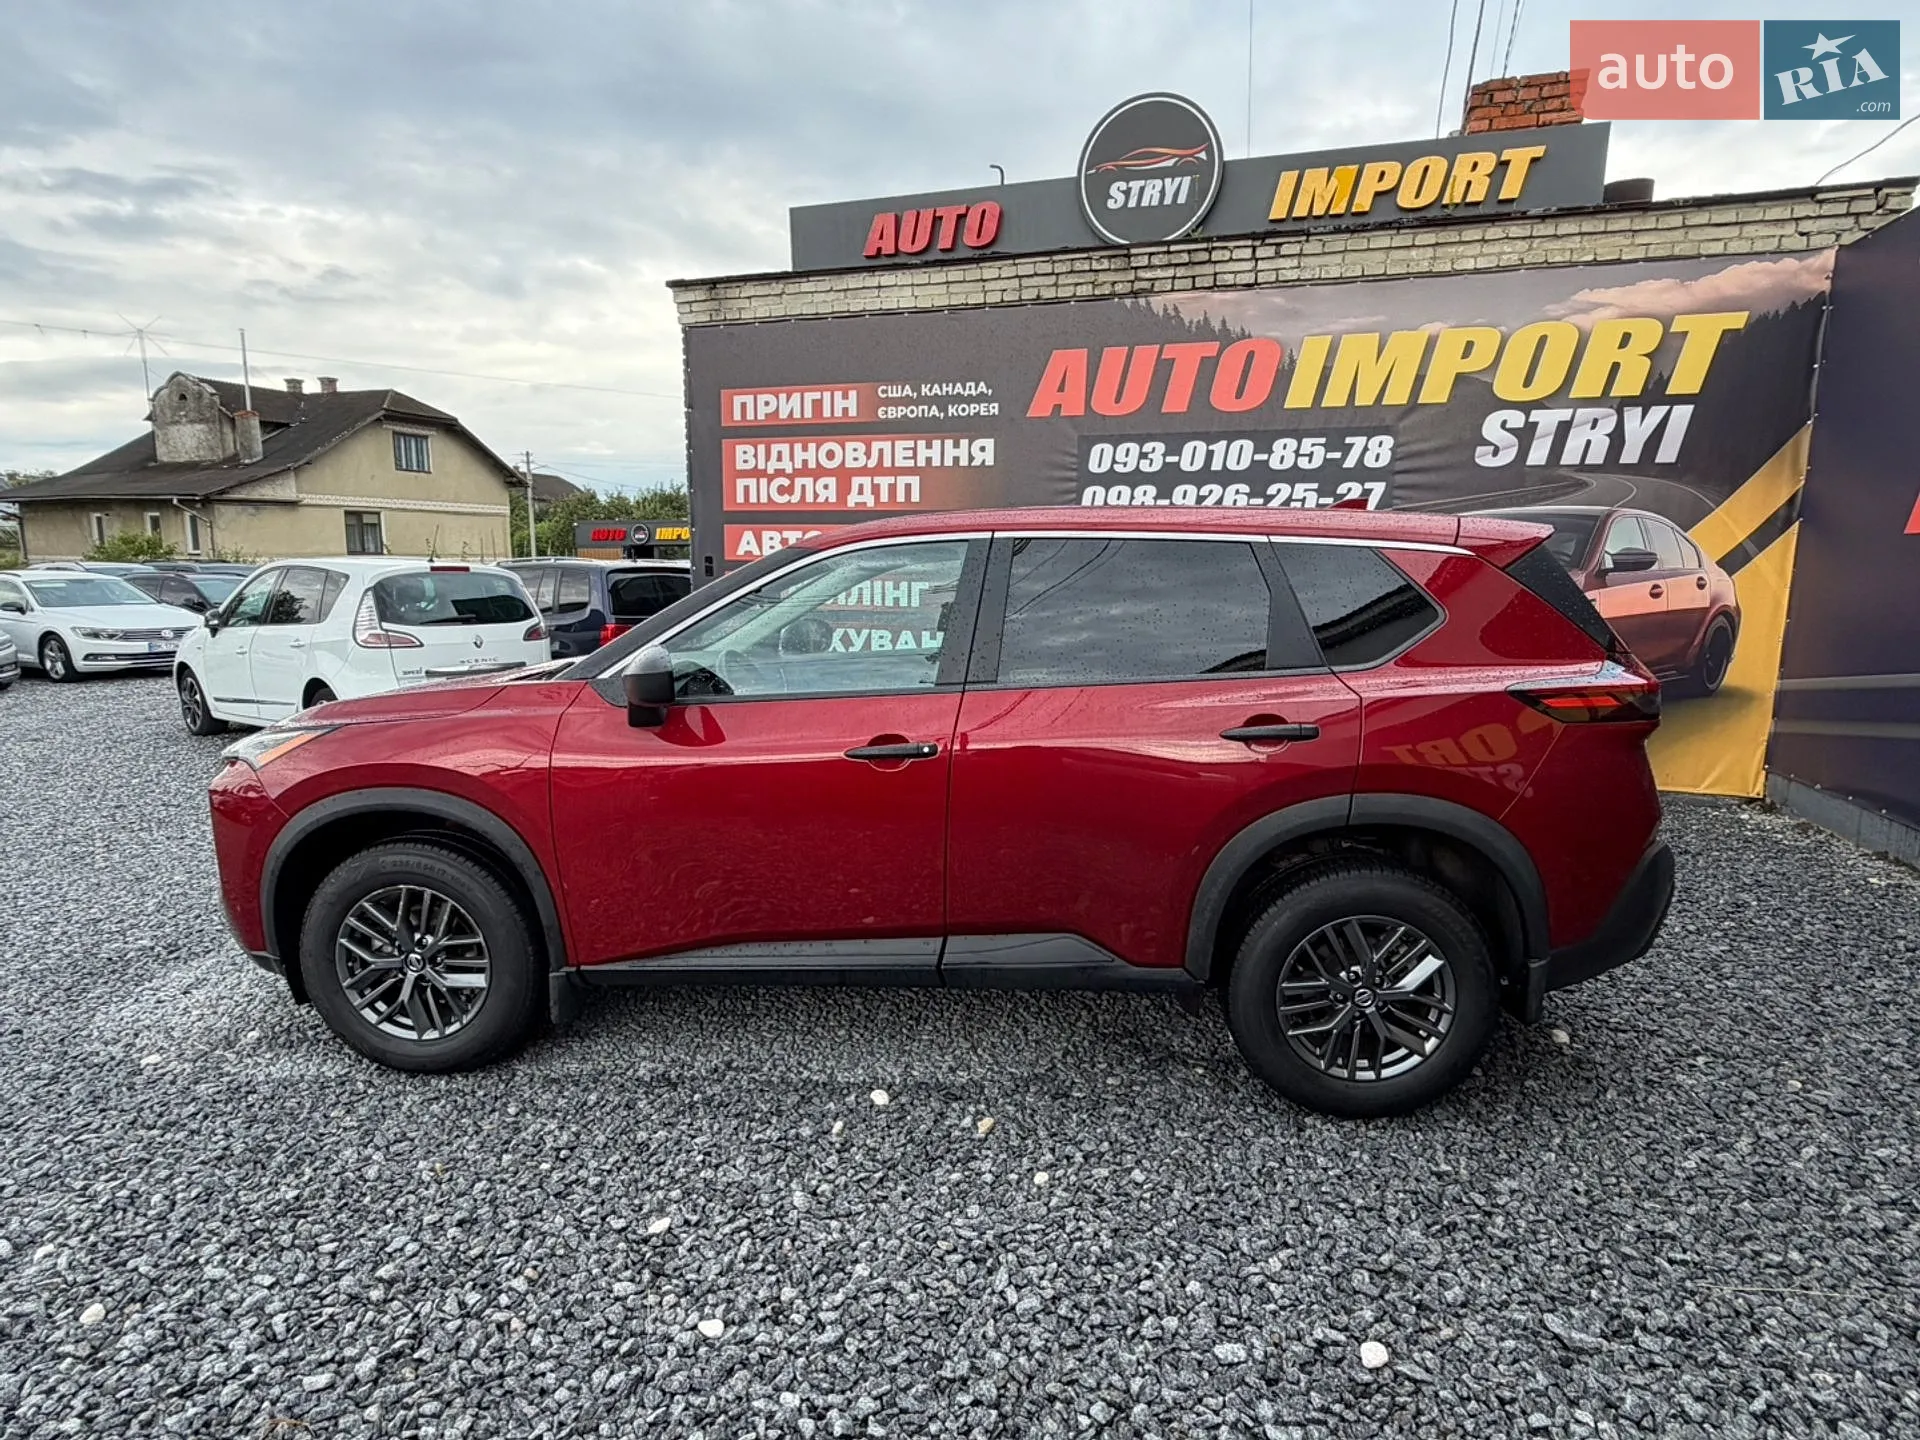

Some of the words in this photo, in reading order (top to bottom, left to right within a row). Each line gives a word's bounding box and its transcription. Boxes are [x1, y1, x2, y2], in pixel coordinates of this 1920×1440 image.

[863, 200, 1004, 259] AUTO
[1268, 145, 1547, 221] IMPORT
[1106, 174, 1193, 211] STRYI
[733, 389, 858, 421] ПРИГІН
[877, 384, 918, 399] США,
[921, 381, 993, 397] КАНАДА,
[877, 404, 944, 420] ЄВРОПА,
[947, 402, 999, 417] КОРЕЯ
[1474, 404, 1696, 468] STRYI
[735, 438, 995, 474] ВІДНОВЛЕННЯ
[1088, 435, 1395, 474] 093-010-85-78
[736, 477, 837, 504] ПІСЛЯ
[847, 475, 920, 508] ДТП
[735, 530, 822, 557] АВТ
